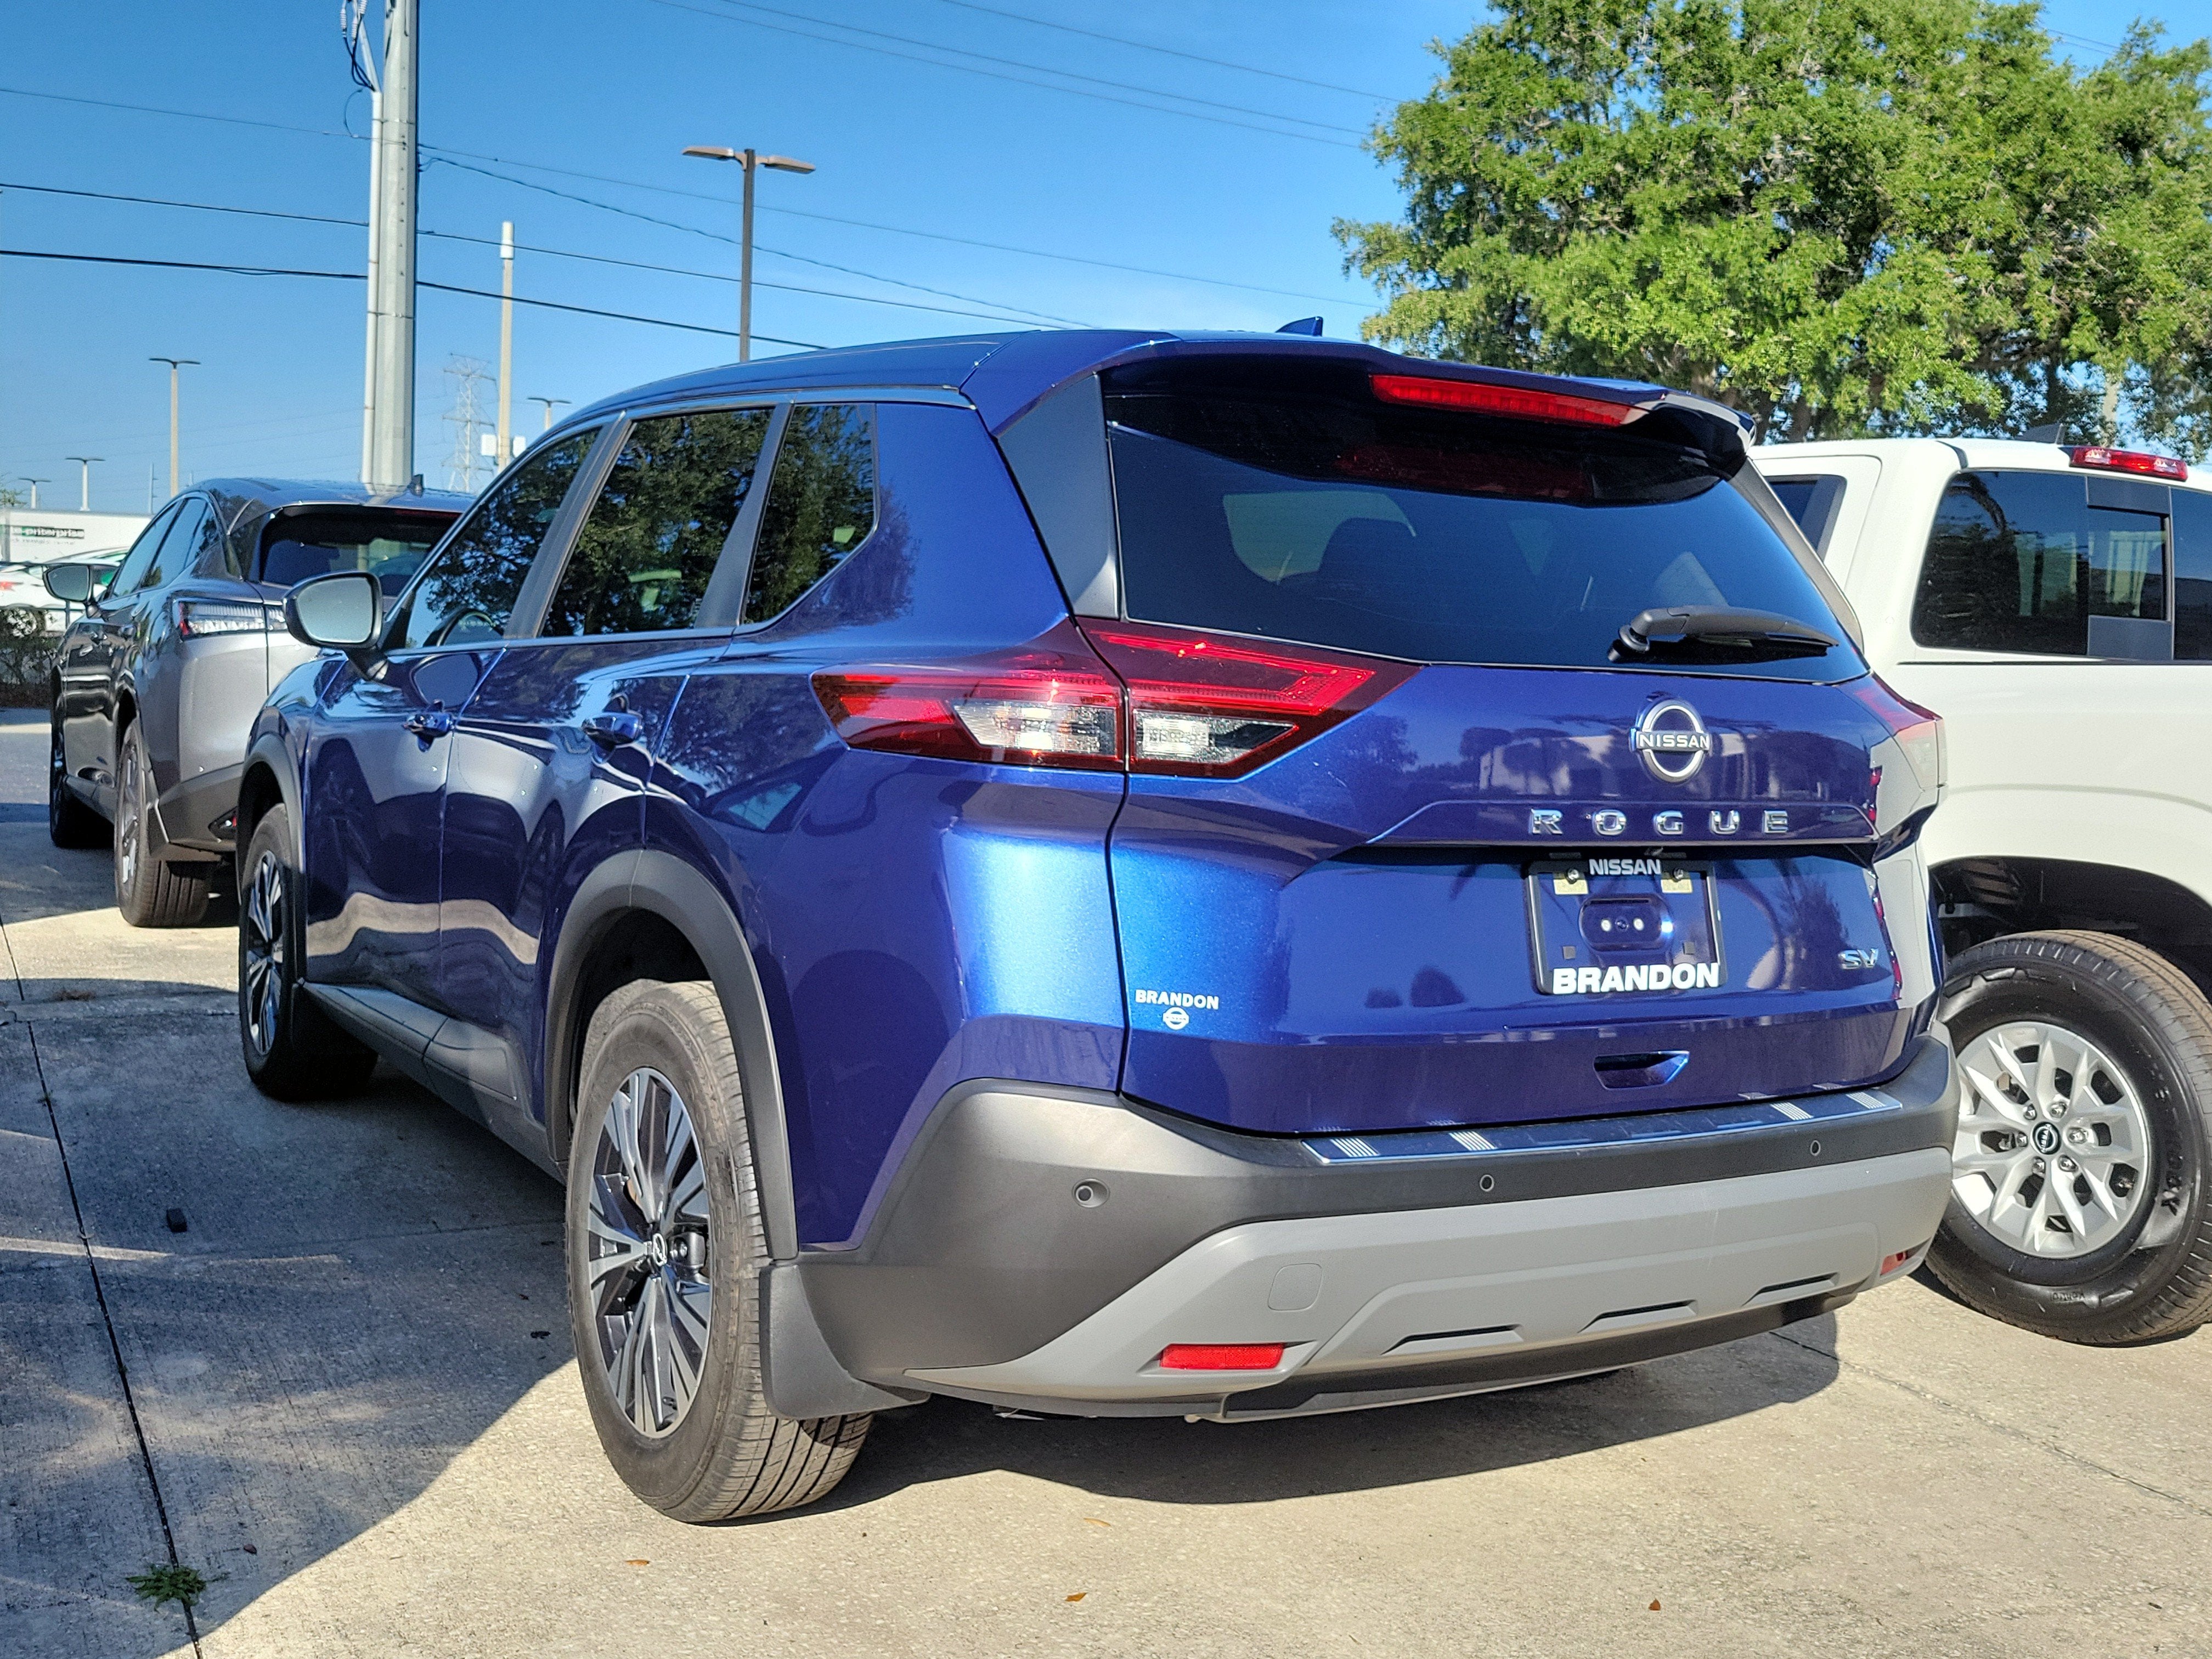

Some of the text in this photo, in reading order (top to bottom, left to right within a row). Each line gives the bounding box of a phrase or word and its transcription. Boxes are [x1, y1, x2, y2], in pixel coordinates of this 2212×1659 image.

[1639, 734, 1709, 748] NISSAN
[1530, 809, 1788, 836] ROGUE
[1589, 859, 1662, 876] NISSAN
[1838, 948, 1878, 969] SV
[1553, 962, 1719, 995] BRANDON
[1135, 989, 1219, 1010] BRANDON
